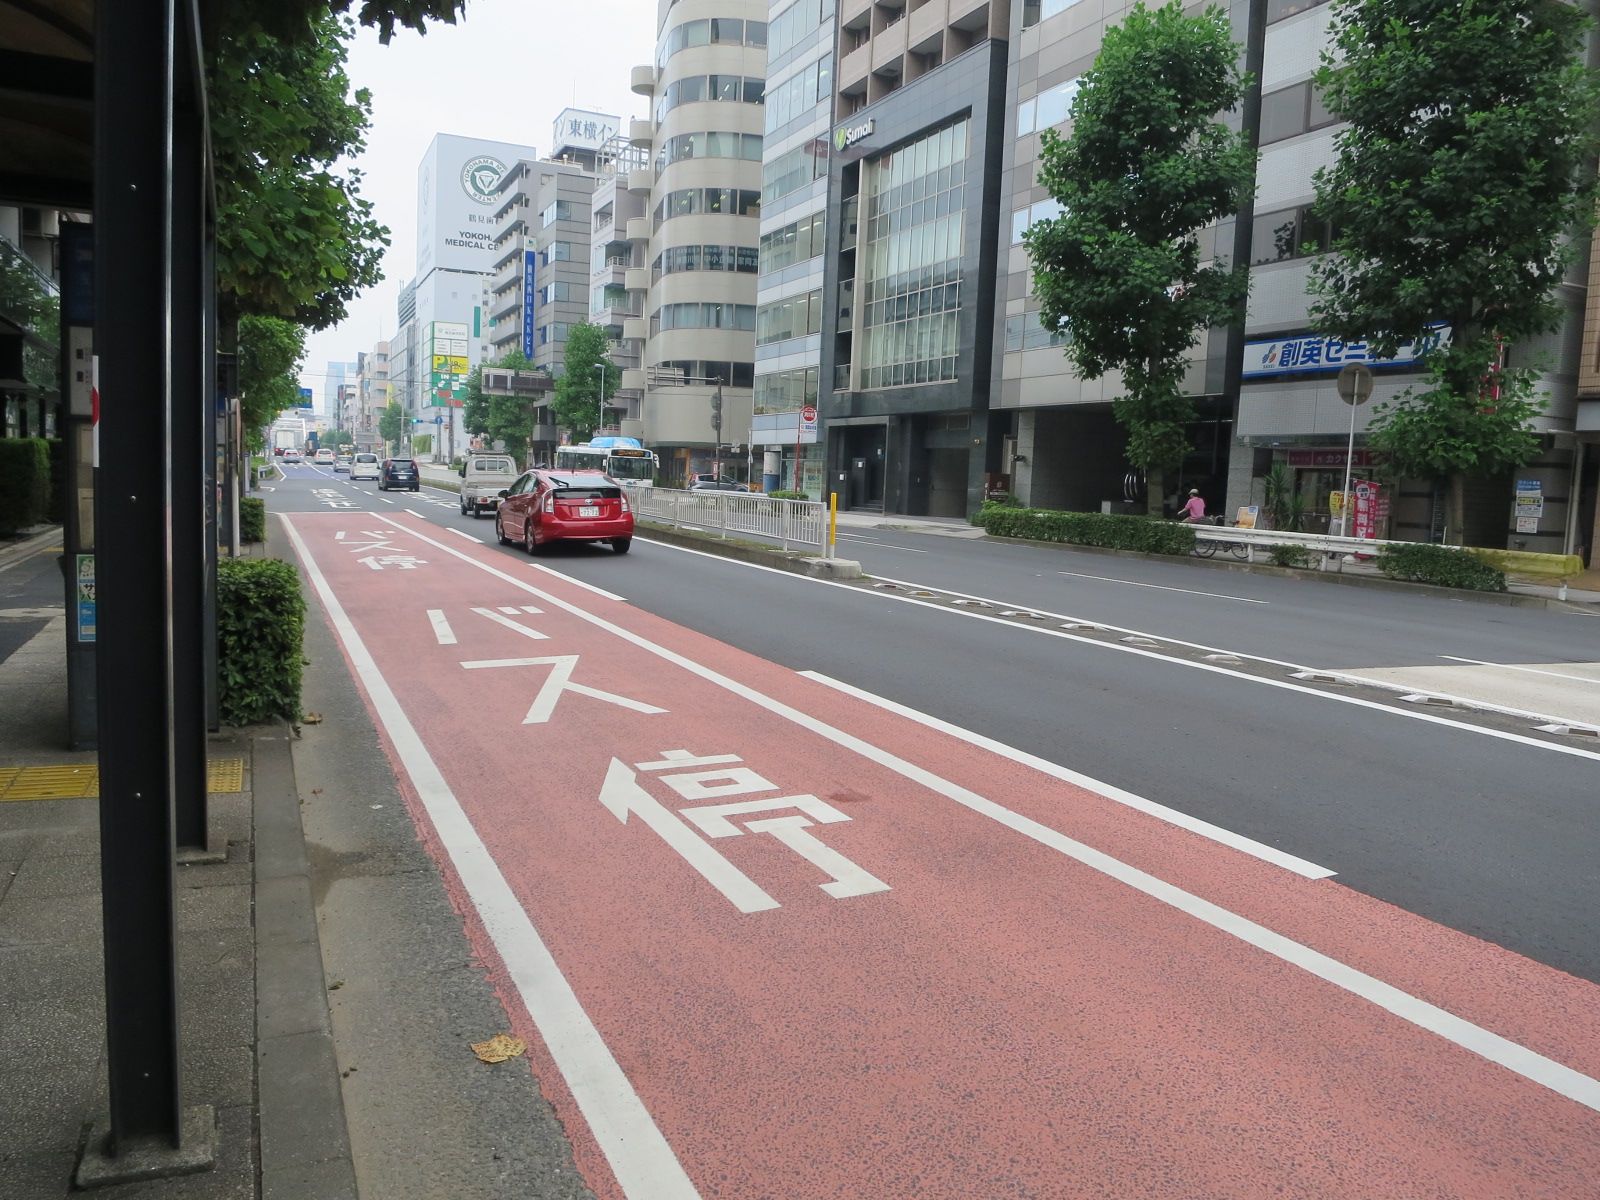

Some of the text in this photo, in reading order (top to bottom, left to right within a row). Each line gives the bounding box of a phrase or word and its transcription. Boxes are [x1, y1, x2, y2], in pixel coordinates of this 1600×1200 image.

[568, 118, 618, 142] 東横イン
[464, 159, 494, 183] YOKOHAMA
[445, 238, 486, 250] MEDICAL
[325, 530, 430, 571] バス停
[426, 606, 892, 914] バス停
